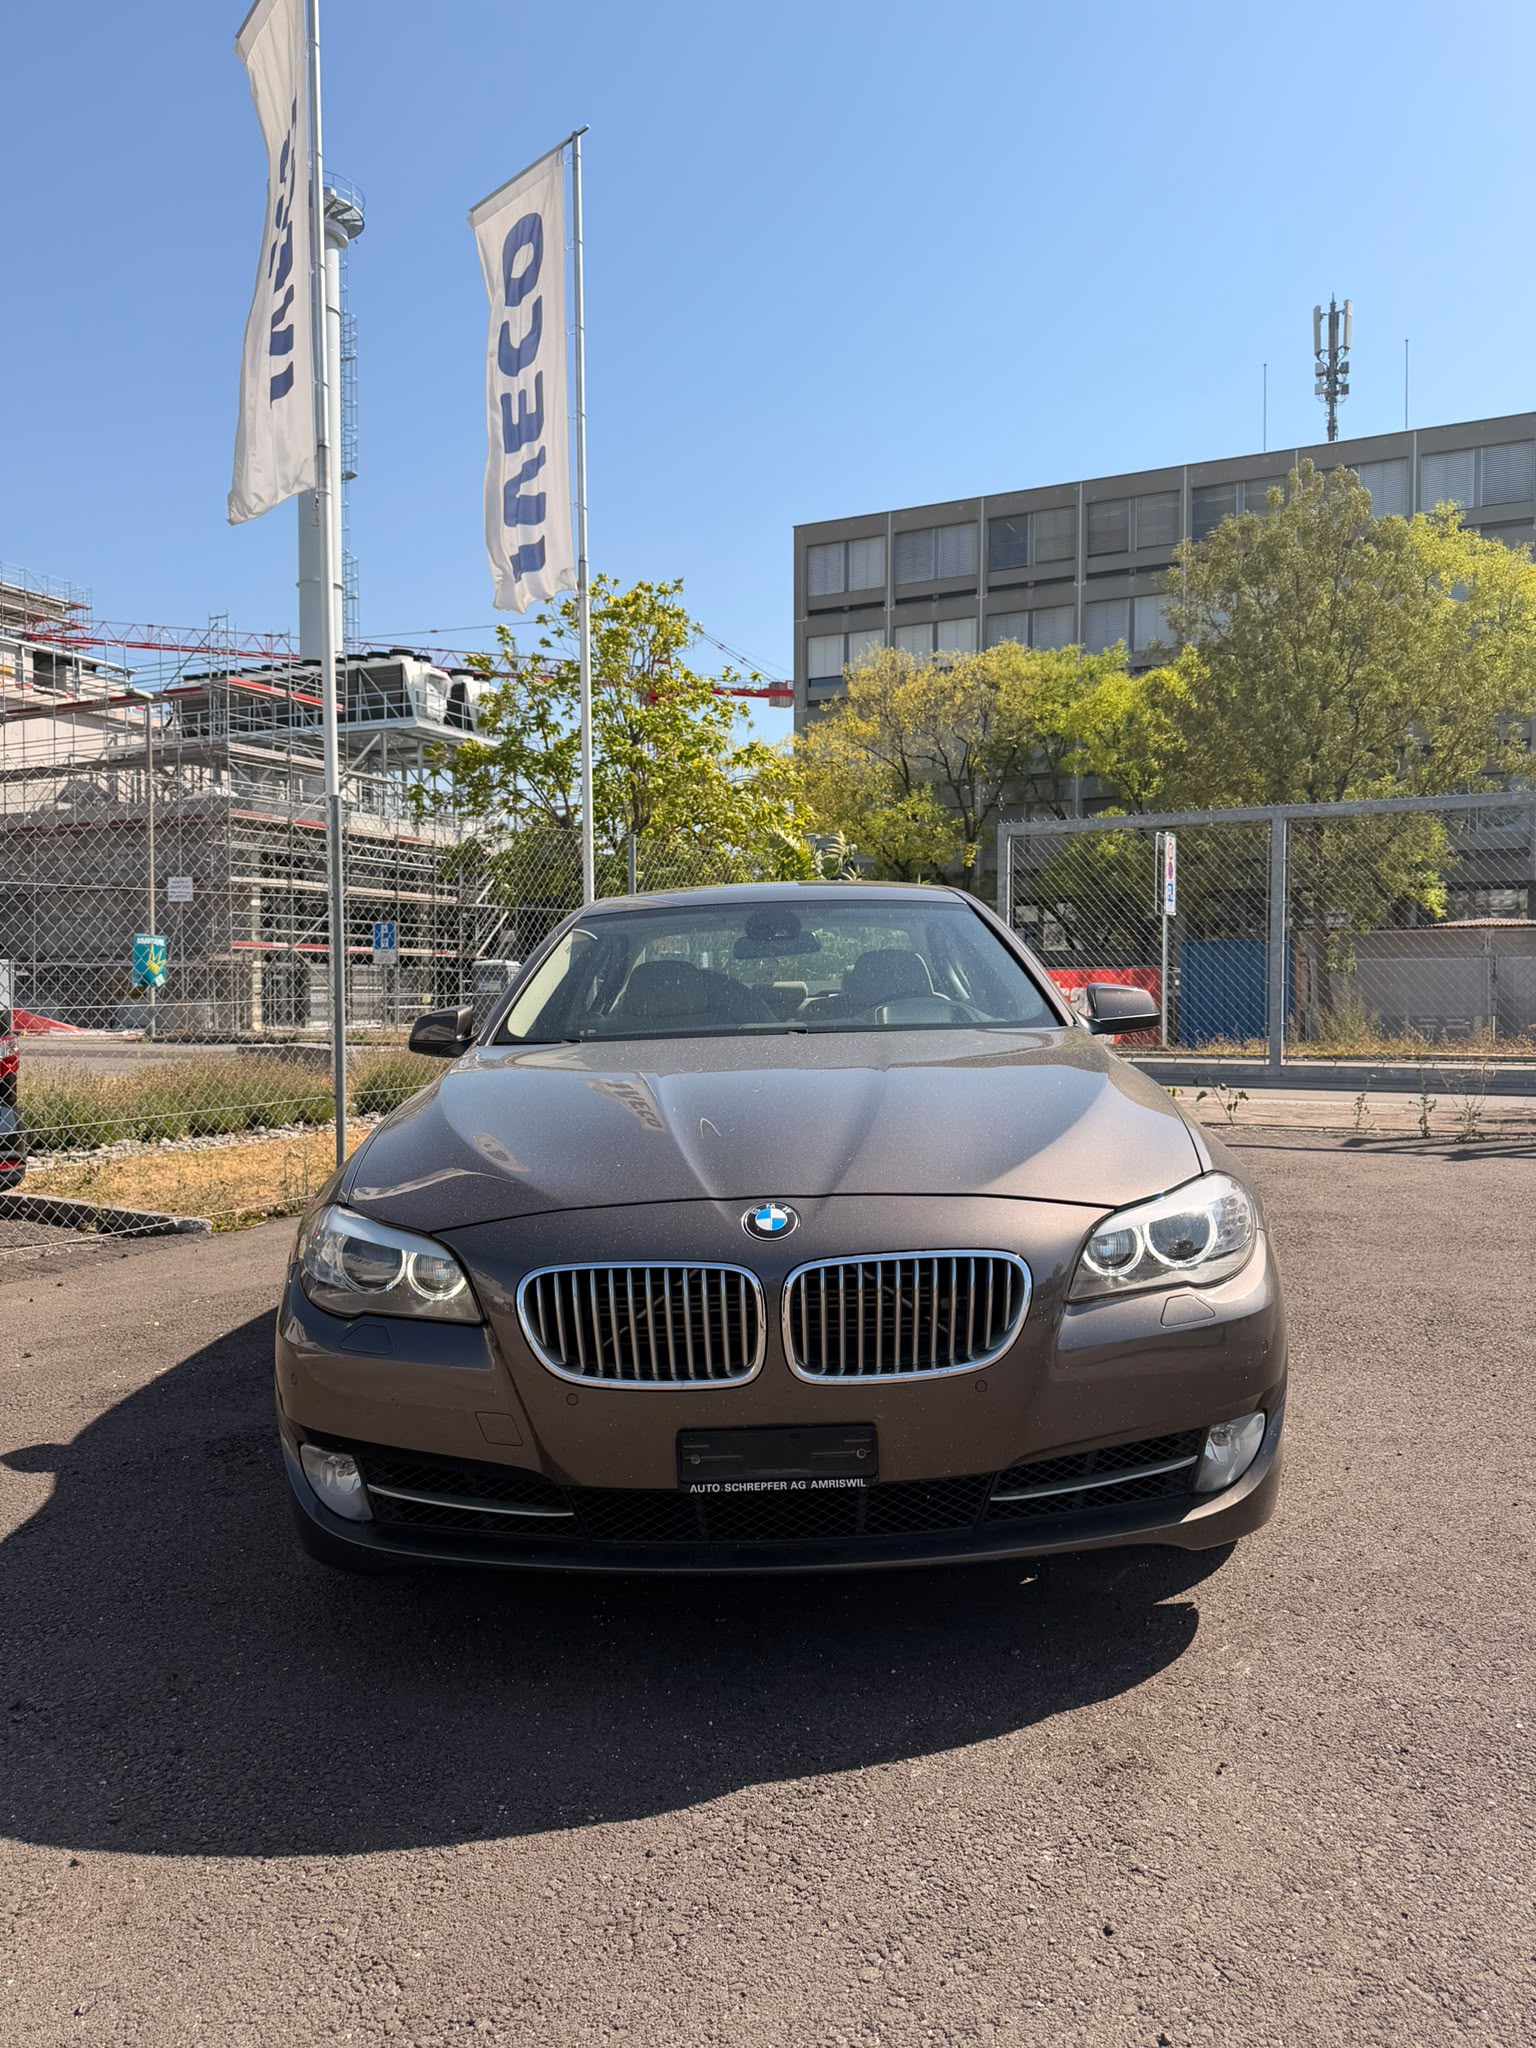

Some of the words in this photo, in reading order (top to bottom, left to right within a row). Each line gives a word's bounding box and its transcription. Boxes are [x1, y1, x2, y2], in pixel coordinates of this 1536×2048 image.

[604, 1081, 663, 1129] IVECO
[751, 1203, 794, 1215] BMW
[689, 1484, 721, 1493] AUTO
[724, 1481, 788, 1493] SCHREPFER
[790, 1480, 807, 1490] AG
[810, 1478, 867, 1489] AMRISWIL
